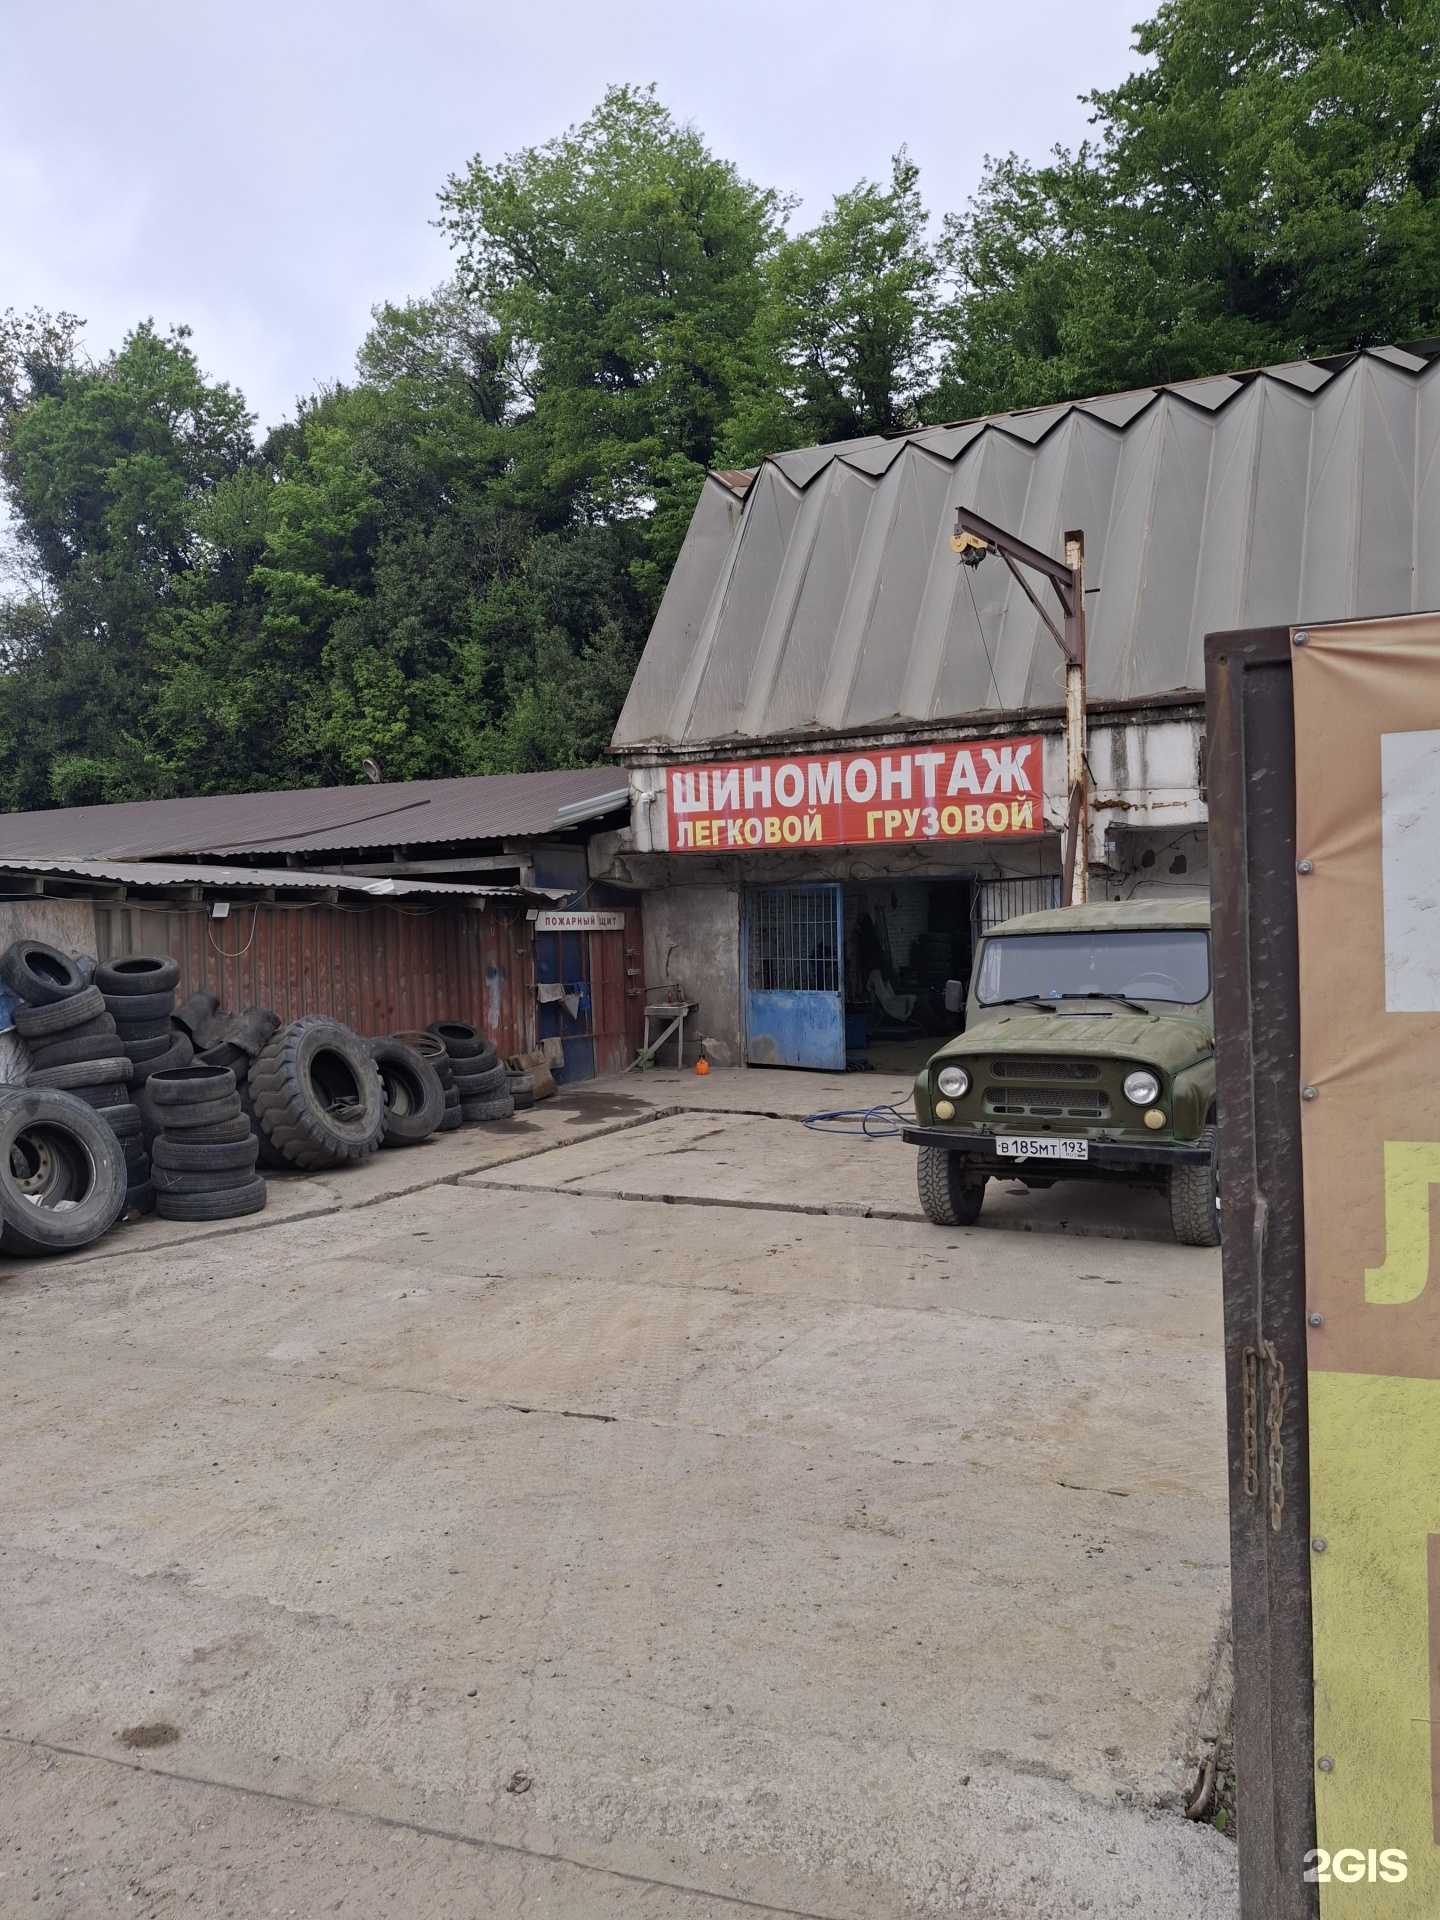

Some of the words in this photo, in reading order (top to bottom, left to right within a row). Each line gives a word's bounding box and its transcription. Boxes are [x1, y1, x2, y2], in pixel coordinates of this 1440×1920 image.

[672, 744, 1032, 813] ШИНОМОНТАЖ
[677, 808, 823, 847] ЛЕГКОВОЙ
[866, 795, 1033, 839] ГРУЗОВОЙ
[545, 916, 595, 926] ПОЖАРНЫЙ
